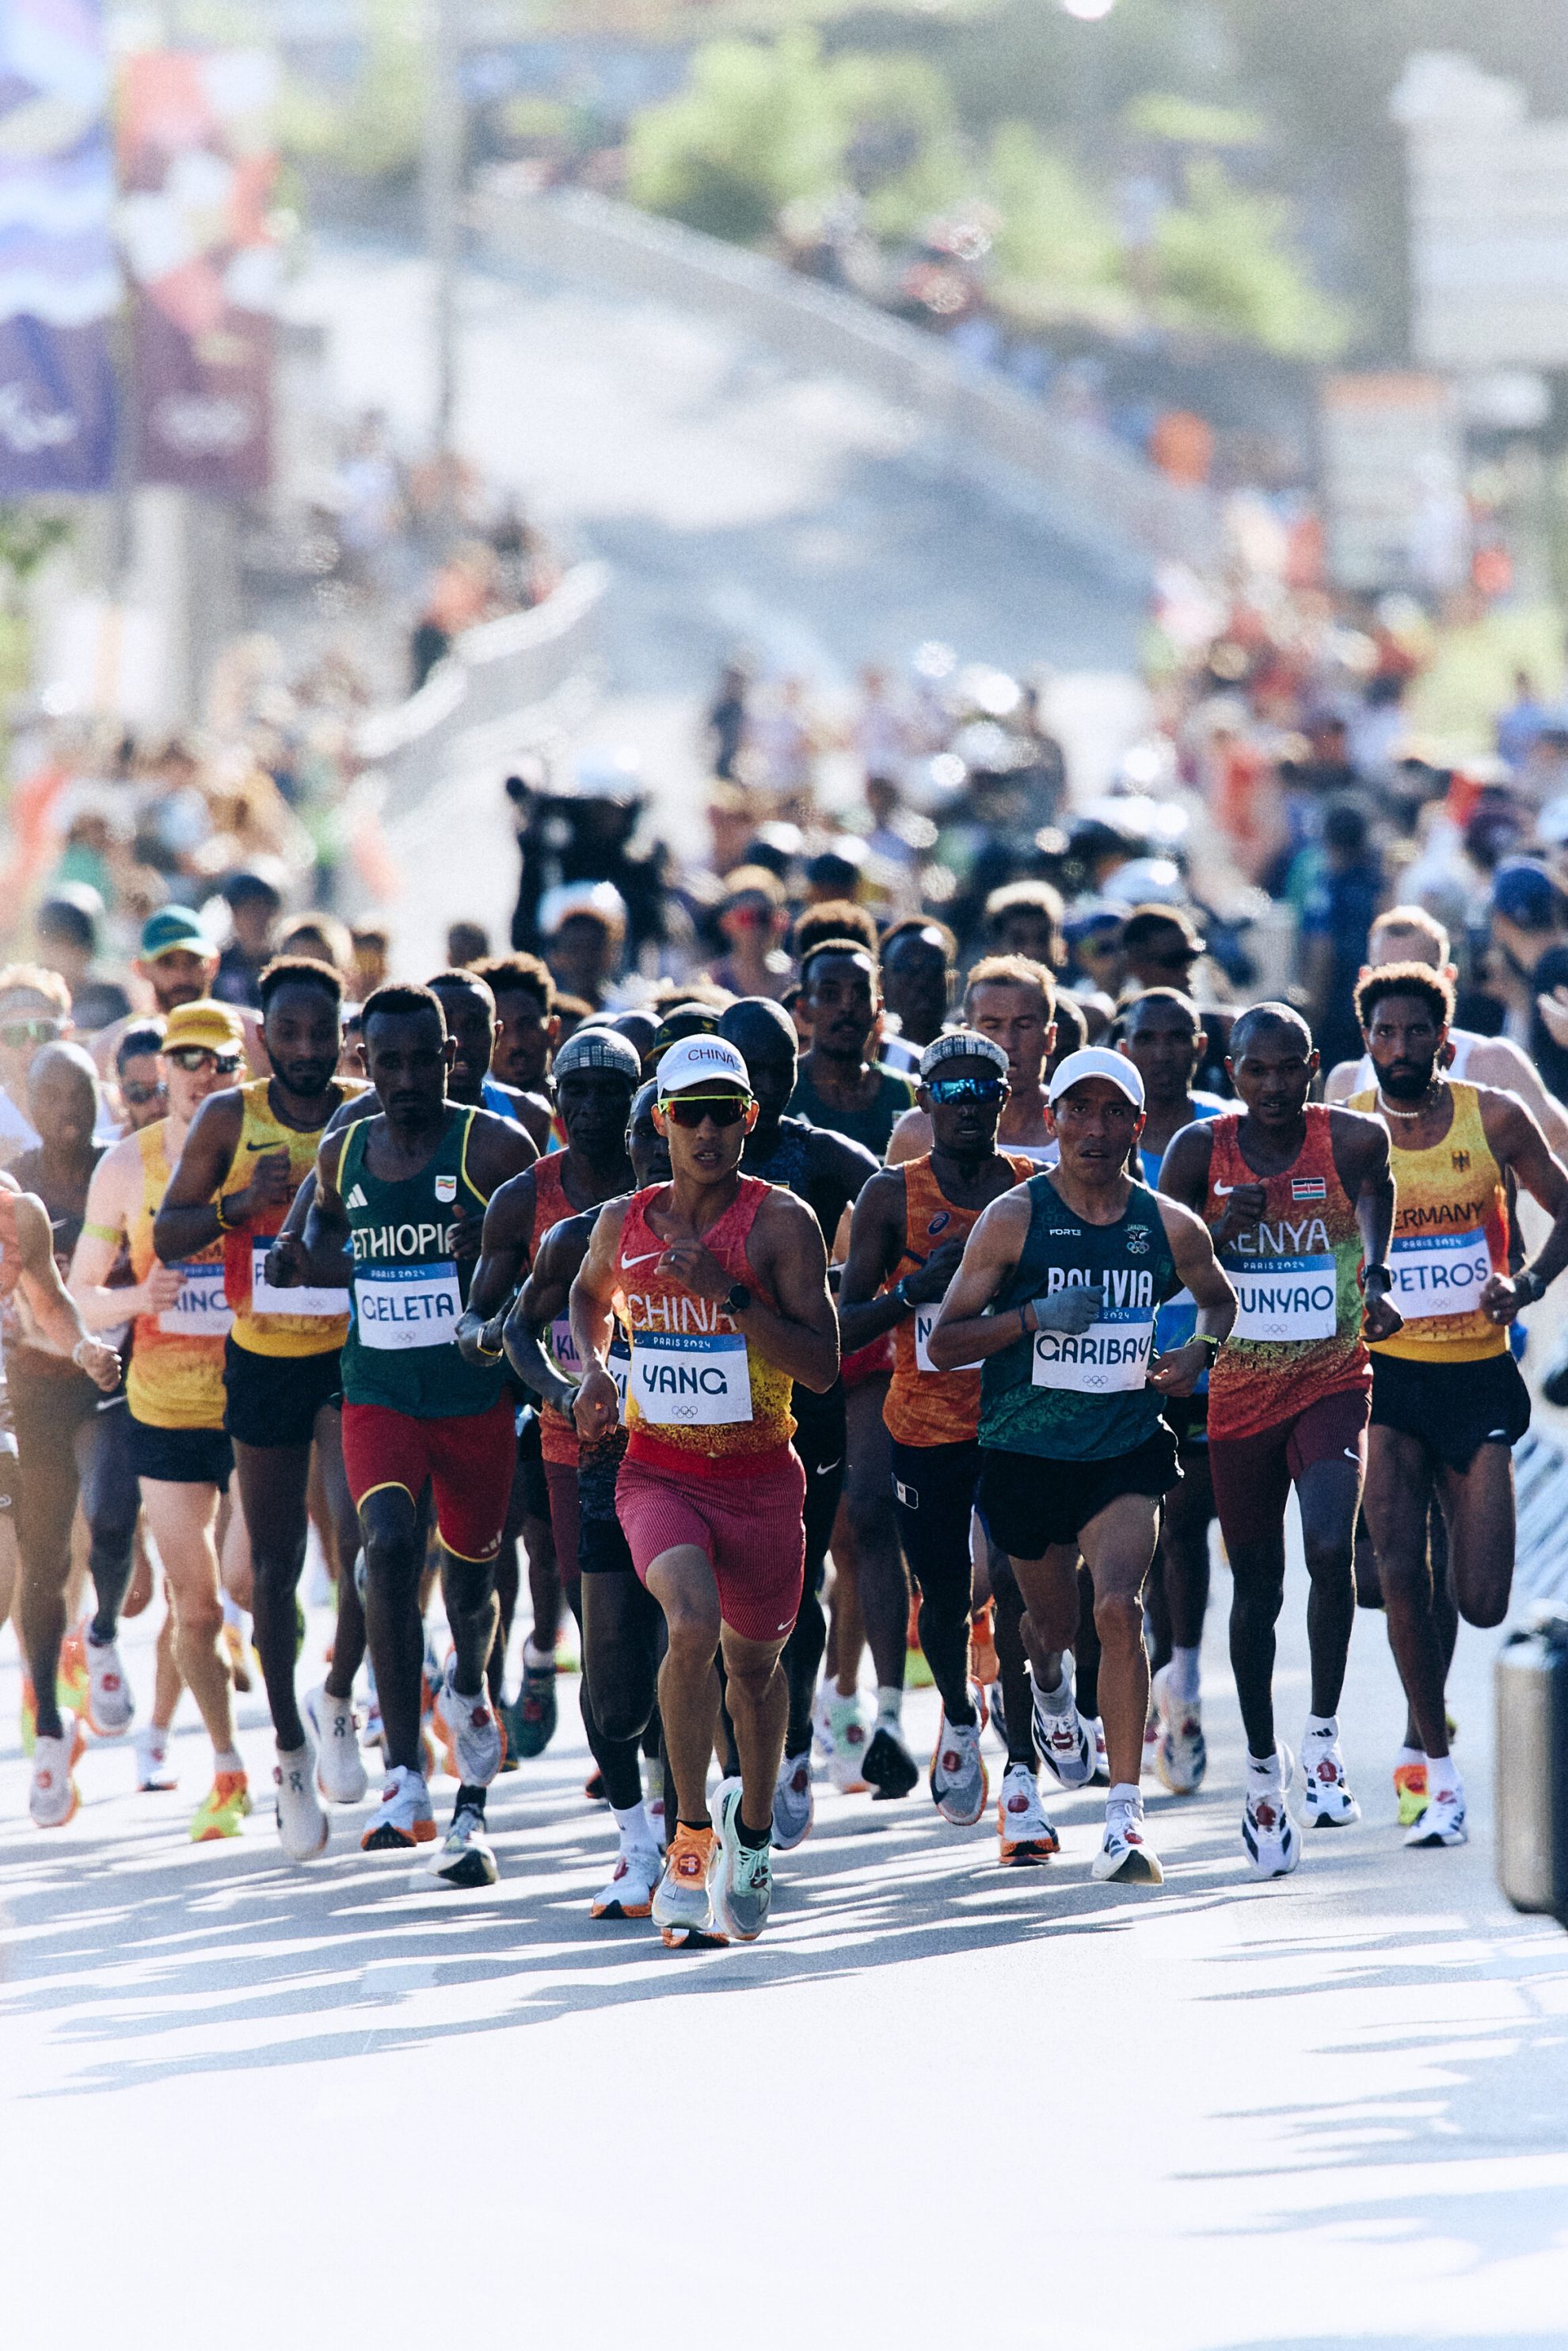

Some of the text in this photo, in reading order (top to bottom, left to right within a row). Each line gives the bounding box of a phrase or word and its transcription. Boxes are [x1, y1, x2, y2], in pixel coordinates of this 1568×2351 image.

[687, 1049, 735, 1069] CHINA
[1395, 1200, 1485, 1229] ERMANY
[1228, 1218, 1330, 1254] ENYA
[371, 1269, 426, 1278] PARIS 2024
[1243, 1260, 1305, 1270] PARIS 2024
[361, 1293, 455, 1322] GELETA
[627, 1294, 738, 1332] CHINA
[1235, 1285, 1334, 1314] UNYAO
[1103, 1311, 1130, 1320] 2024
[653, 1336, 711, 1349] PARIS 2024
[1036, 1335, 1151, 1365] GARIBAY
[642, 1364, 728, 1394] YANG
